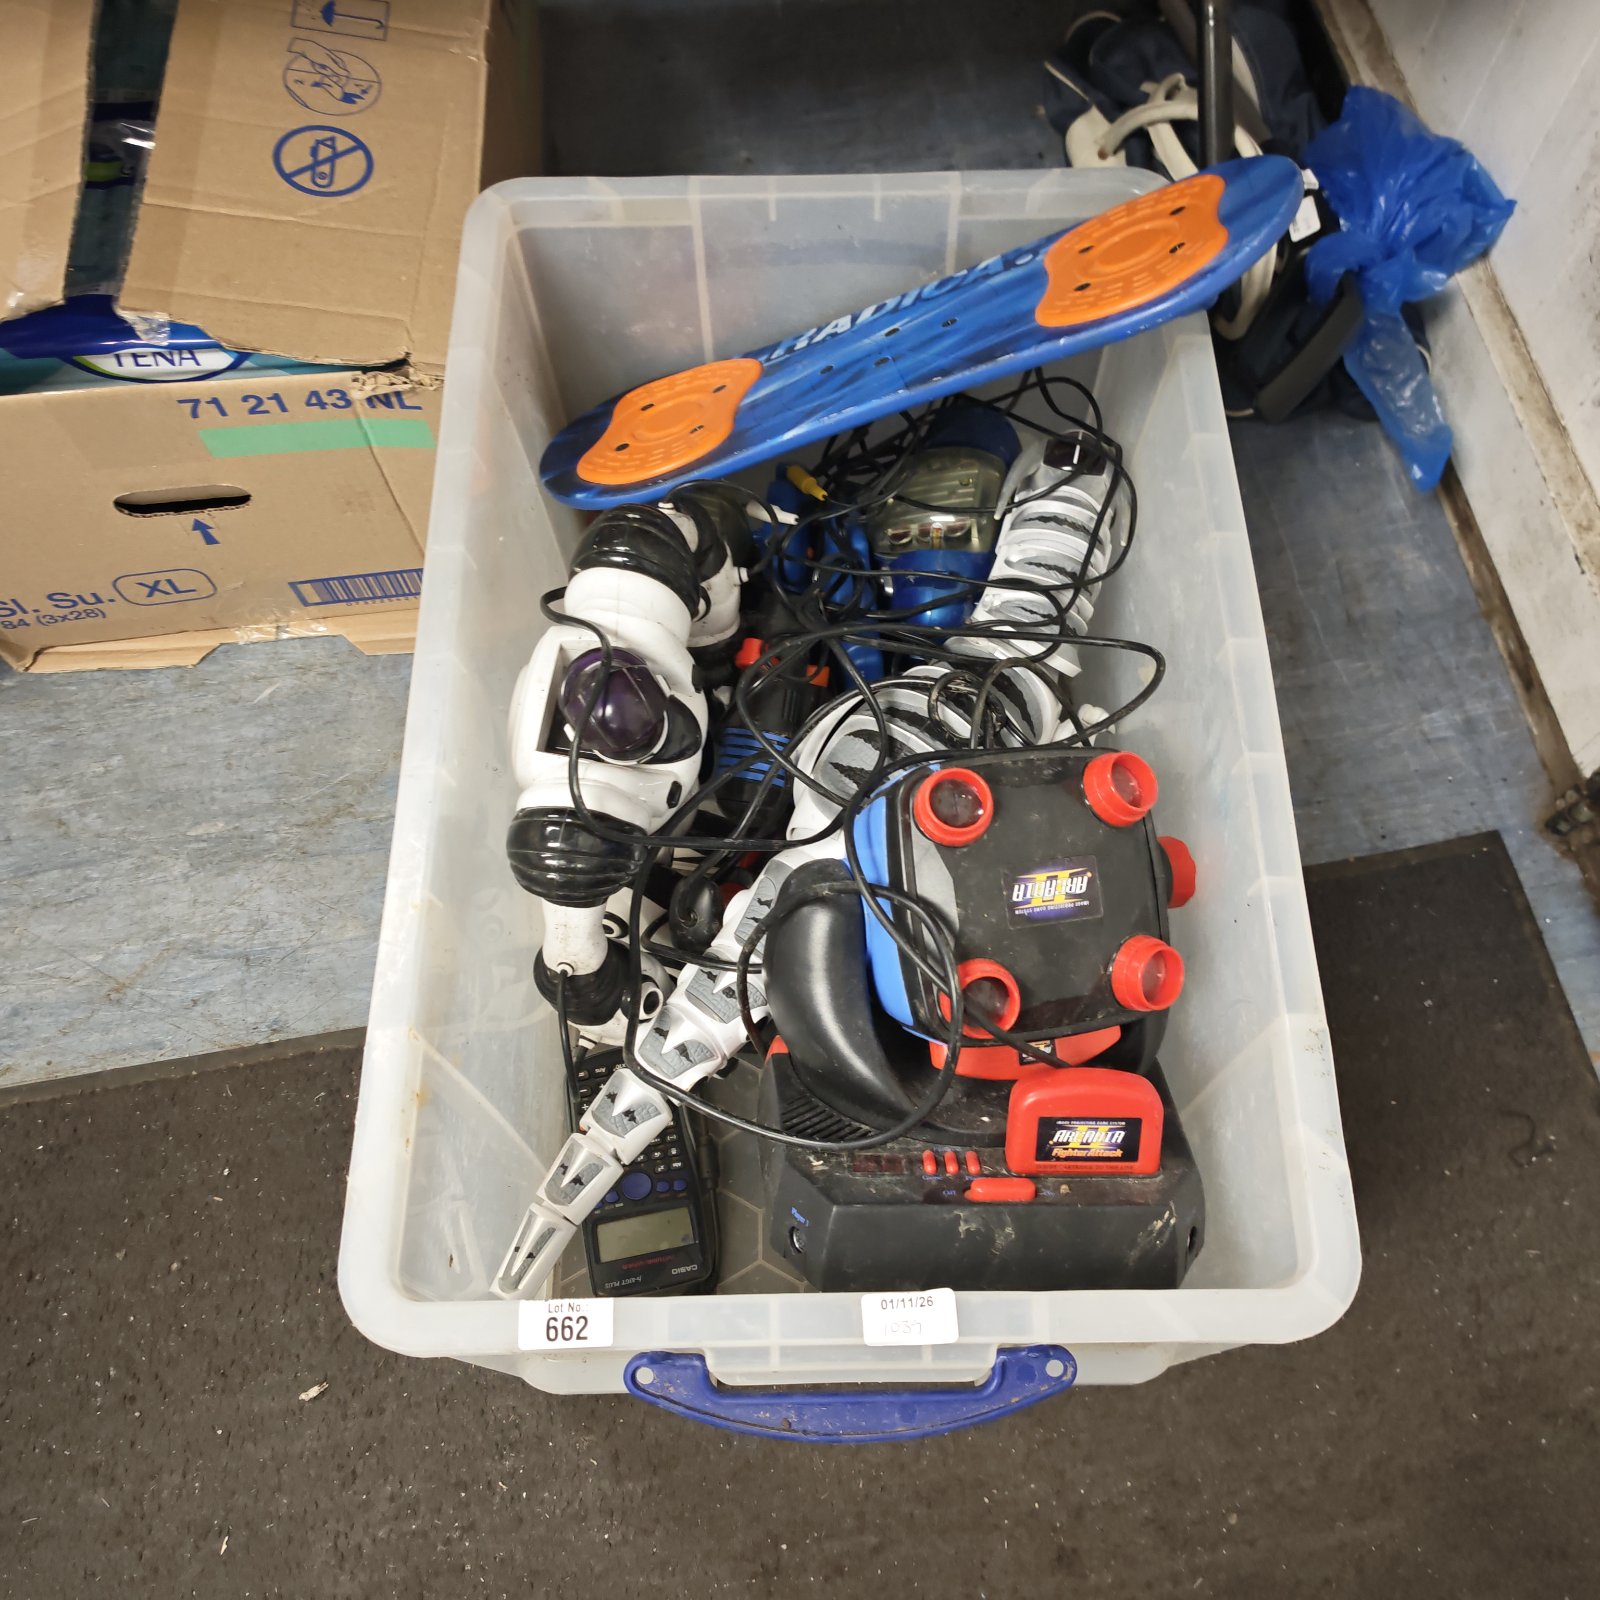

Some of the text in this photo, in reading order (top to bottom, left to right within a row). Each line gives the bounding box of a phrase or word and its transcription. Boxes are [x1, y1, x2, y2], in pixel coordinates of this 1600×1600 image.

[177, 388, 423, 420] 71 21 43 NL
[136, 578, 197, 598] XL
[46, 592, 115, 609] Su.
[1, 608, 107, 630] 84 (3x28)
[1051, 1148, 1123, 1158] Fighter Attack
[672, 1264, 698, 1275] CASIO
[548, 1303, 563, 1314] Lot
[881, 1295, 934, 1310] 01/11/26
[546, 1315, 589, 1342] 662
